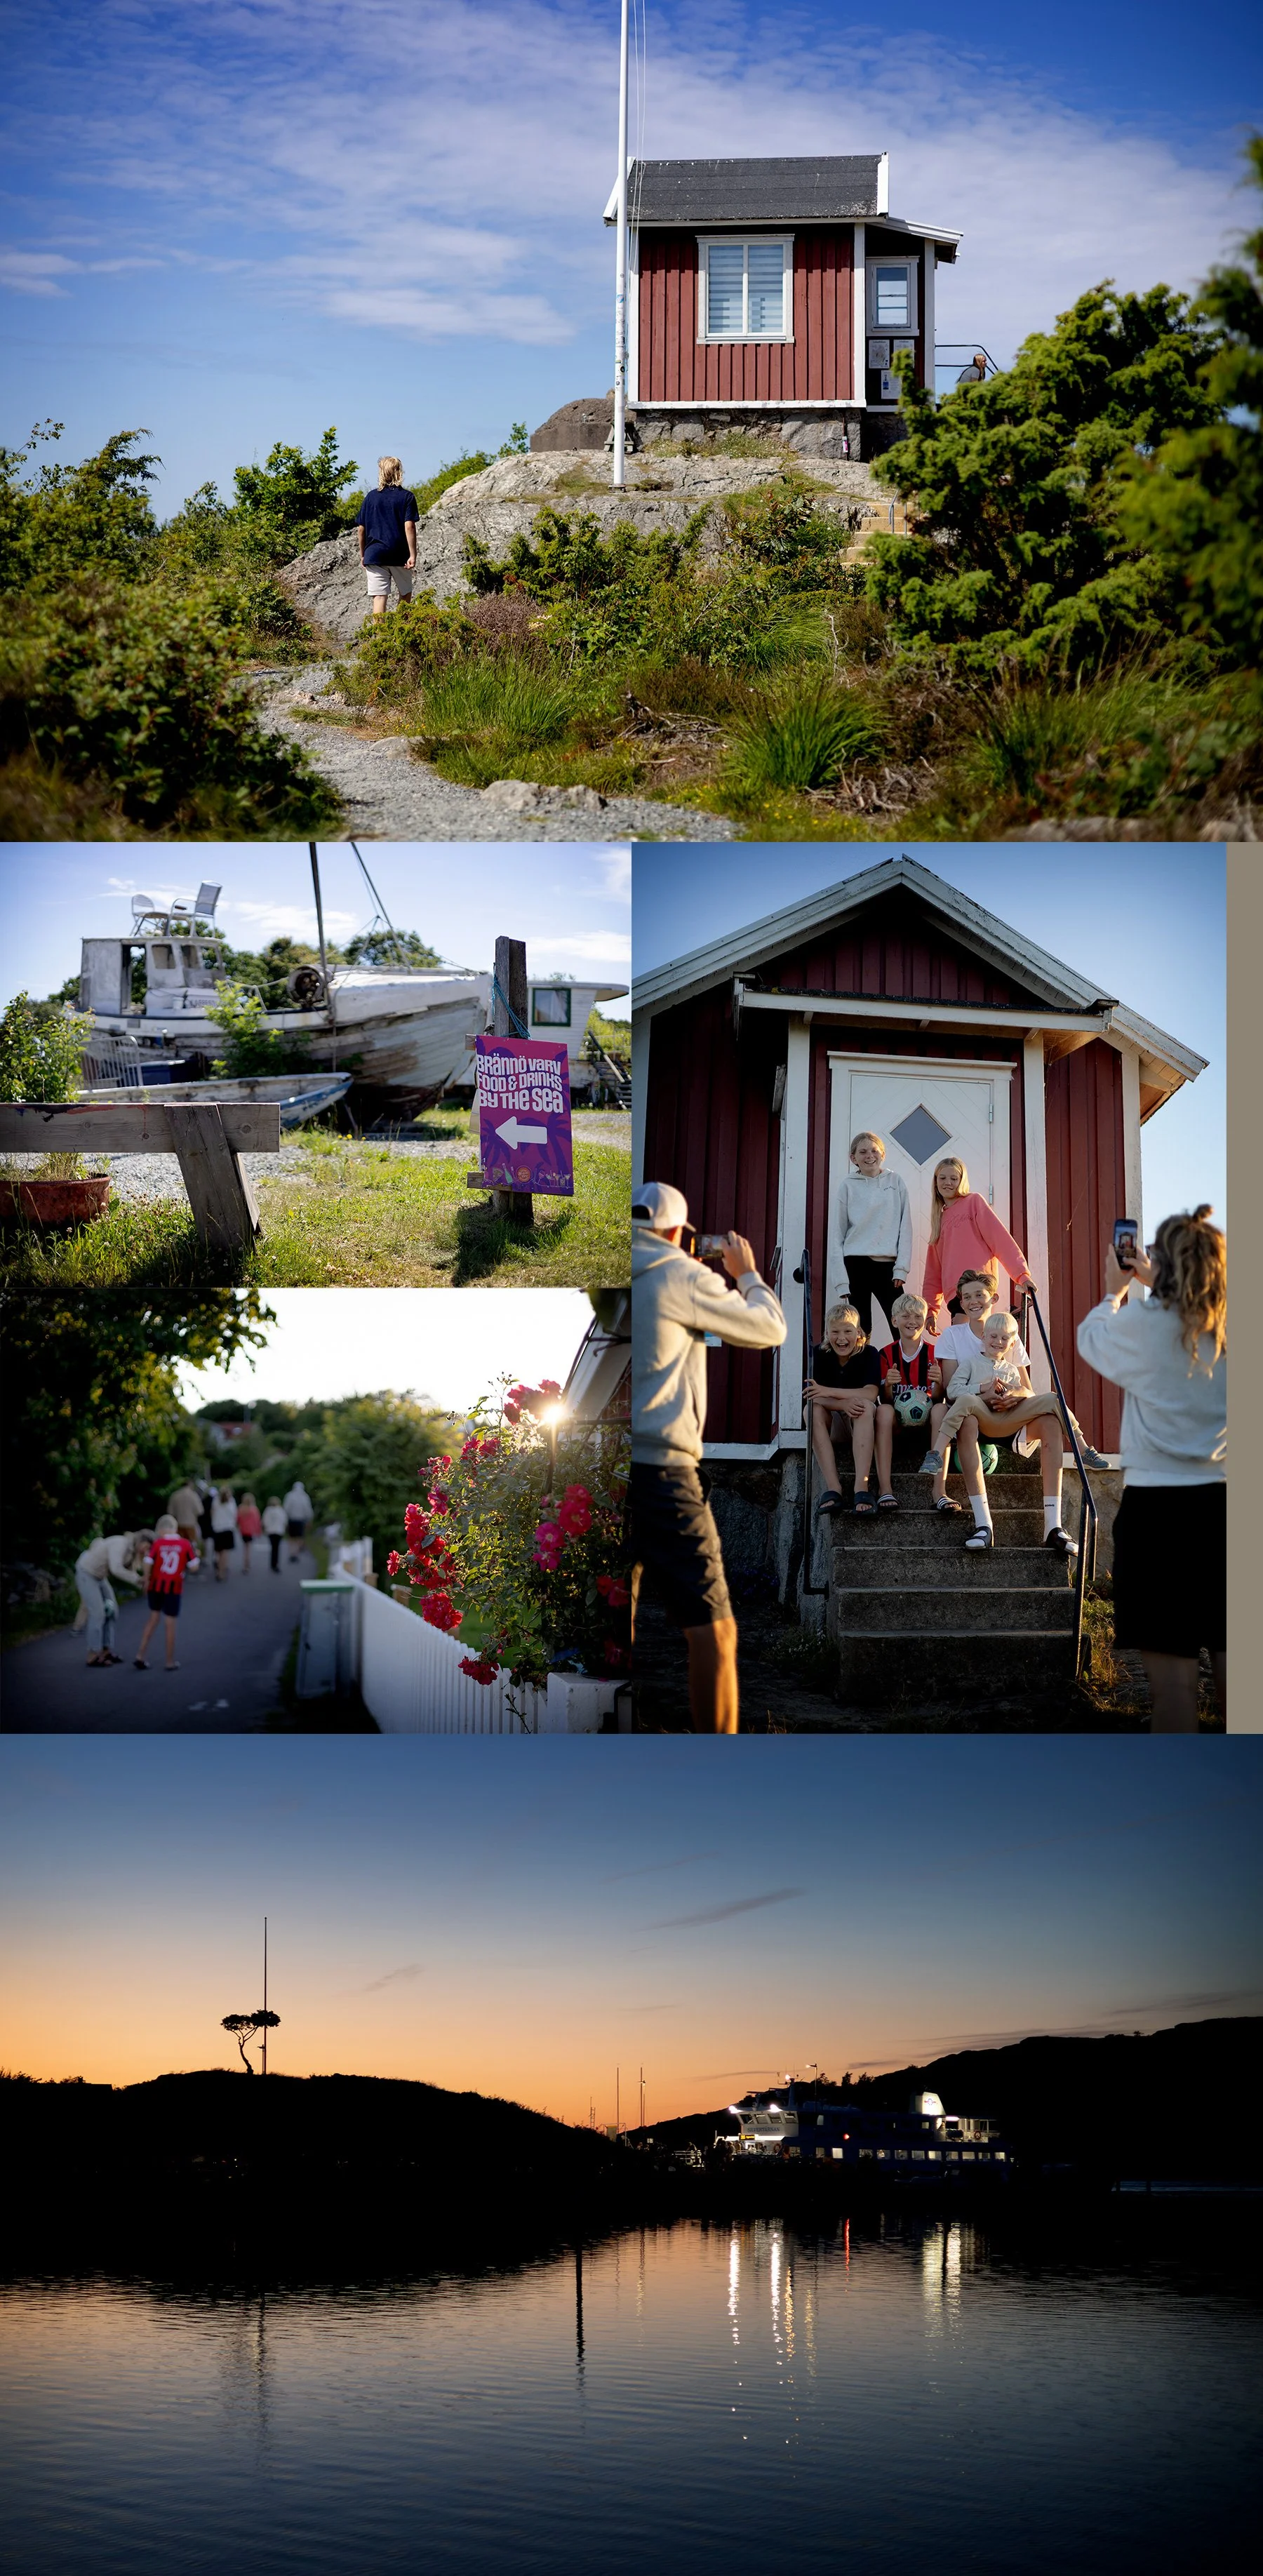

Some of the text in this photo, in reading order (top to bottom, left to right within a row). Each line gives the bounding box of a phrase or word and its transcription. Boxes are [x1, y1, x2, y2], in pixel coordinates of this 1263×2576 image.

[478, 1072, 507, 1092] FOOD
[508, 1076, 518, 1091] &
[160, 1551, 180, 1575] 10
